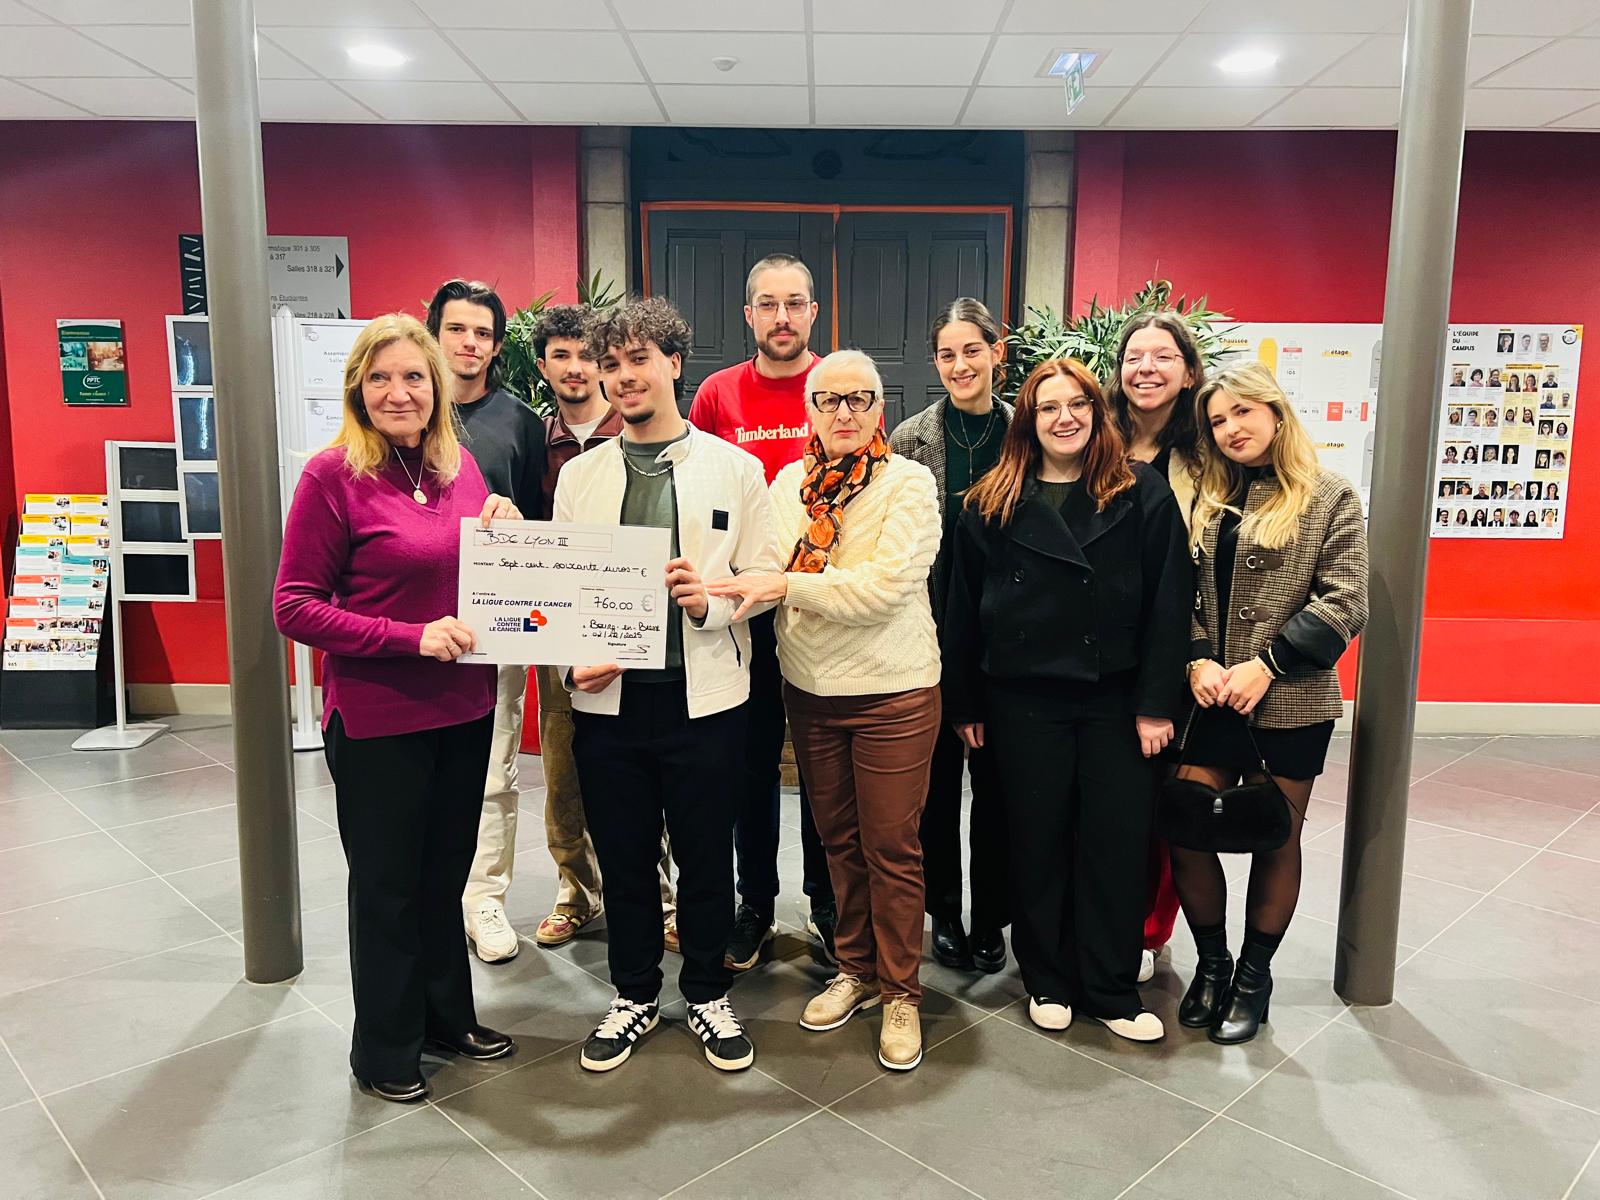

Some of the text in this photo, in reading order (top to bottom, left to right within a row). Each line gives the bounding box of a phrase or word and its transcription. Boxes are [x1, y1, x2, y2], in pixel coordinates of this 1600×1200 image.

[286, 264, 305, 273] Salles
[306, 265, 318, 273] 318
[735, 422, 809, 444] Timberland
[524, 536, 555, 548] LYON
